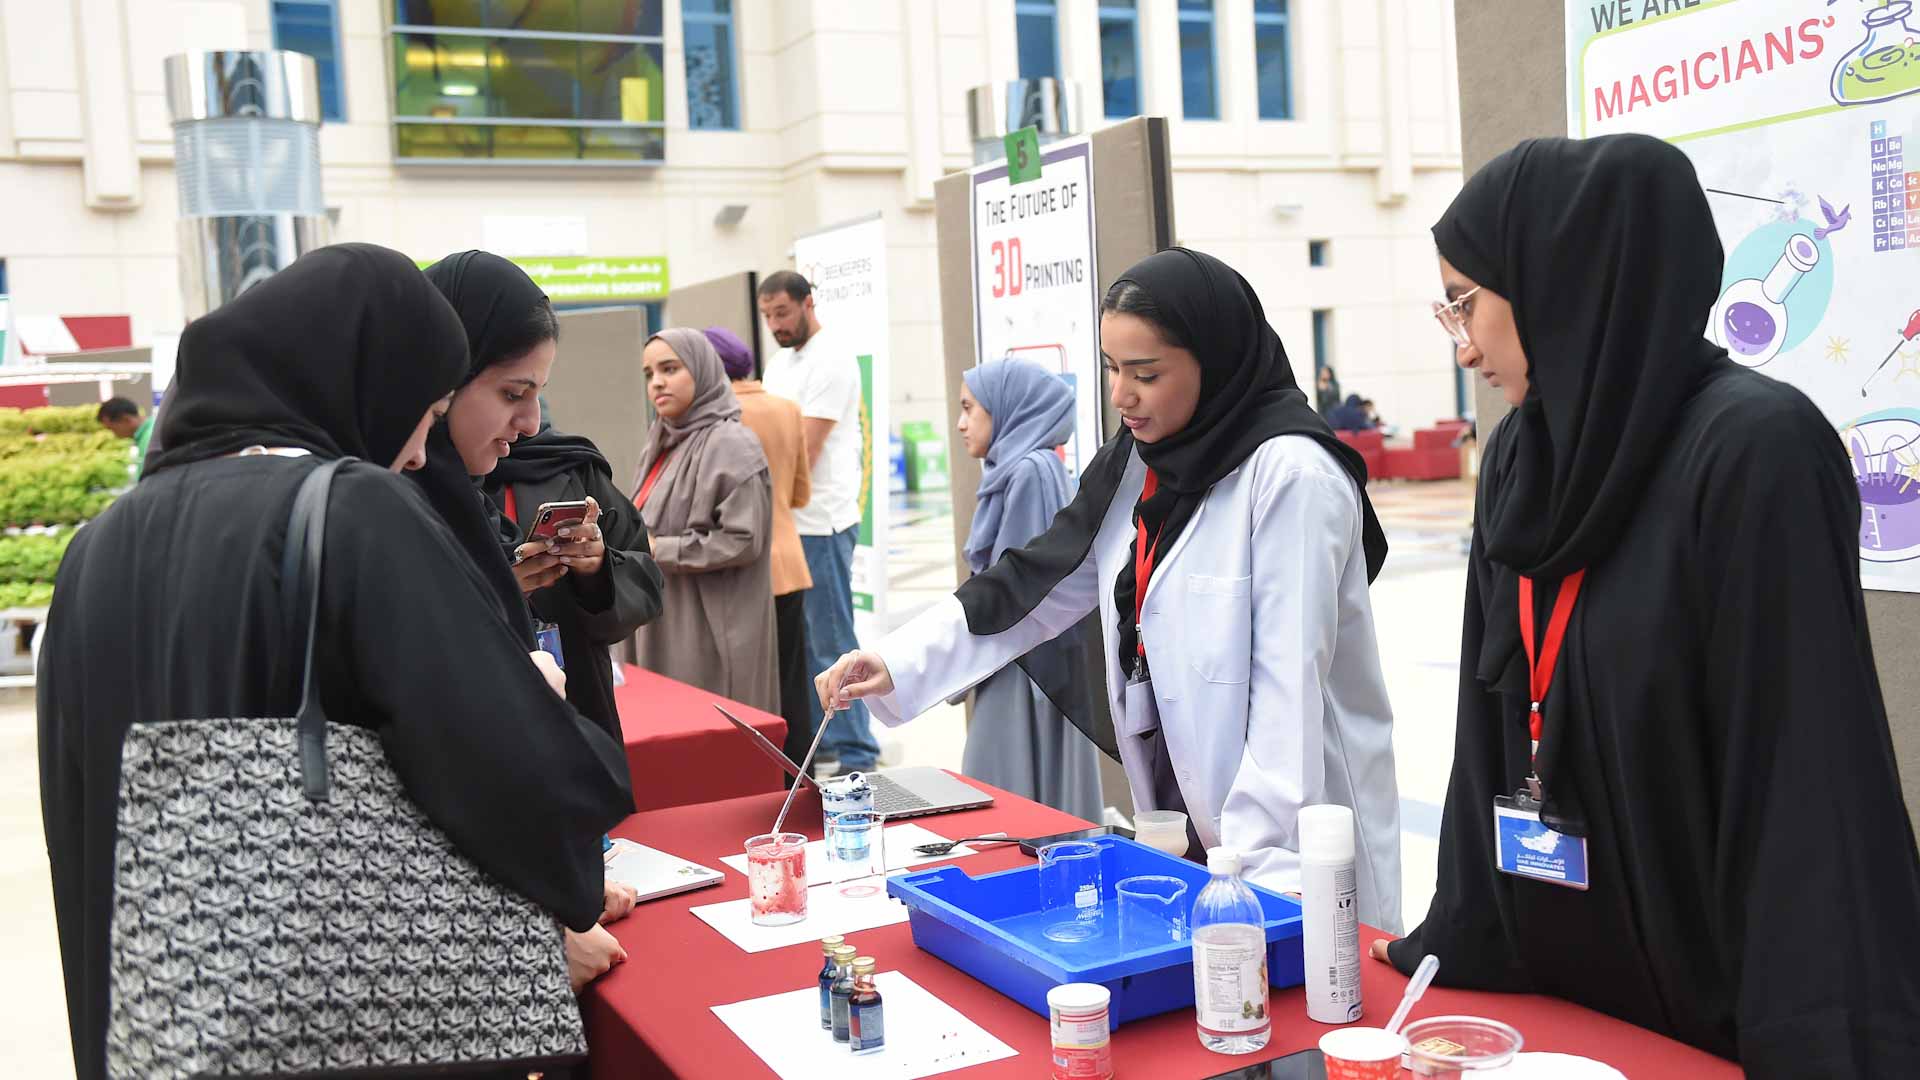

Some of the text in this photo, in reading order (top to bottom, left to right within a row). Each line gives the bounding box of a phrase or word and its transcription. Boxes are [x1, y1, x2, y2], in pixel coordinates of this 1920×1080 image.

[1591, 0, 1633, 33] WE
[1874, 124, 1883, 135] H
[1889, 141, 1901, 150] Be
[1016, 139, 1029, 170] 5
[1872, 159, 1903, 173] Na Mg
[1876, 180, 1884, 191] K
[1889, 178, 1903, 189] Ca
[985, 183, 1077, 227] THE FUTURE OF
[1874, 200, 1887, 210] Rb
[1890, 216, 1904, 226] Ba
[1876, 237, 1887, 248] Fr
[1891, 235, 1905, 246] Ra
[991, 236, 1083, 298] 3D PRINTING
